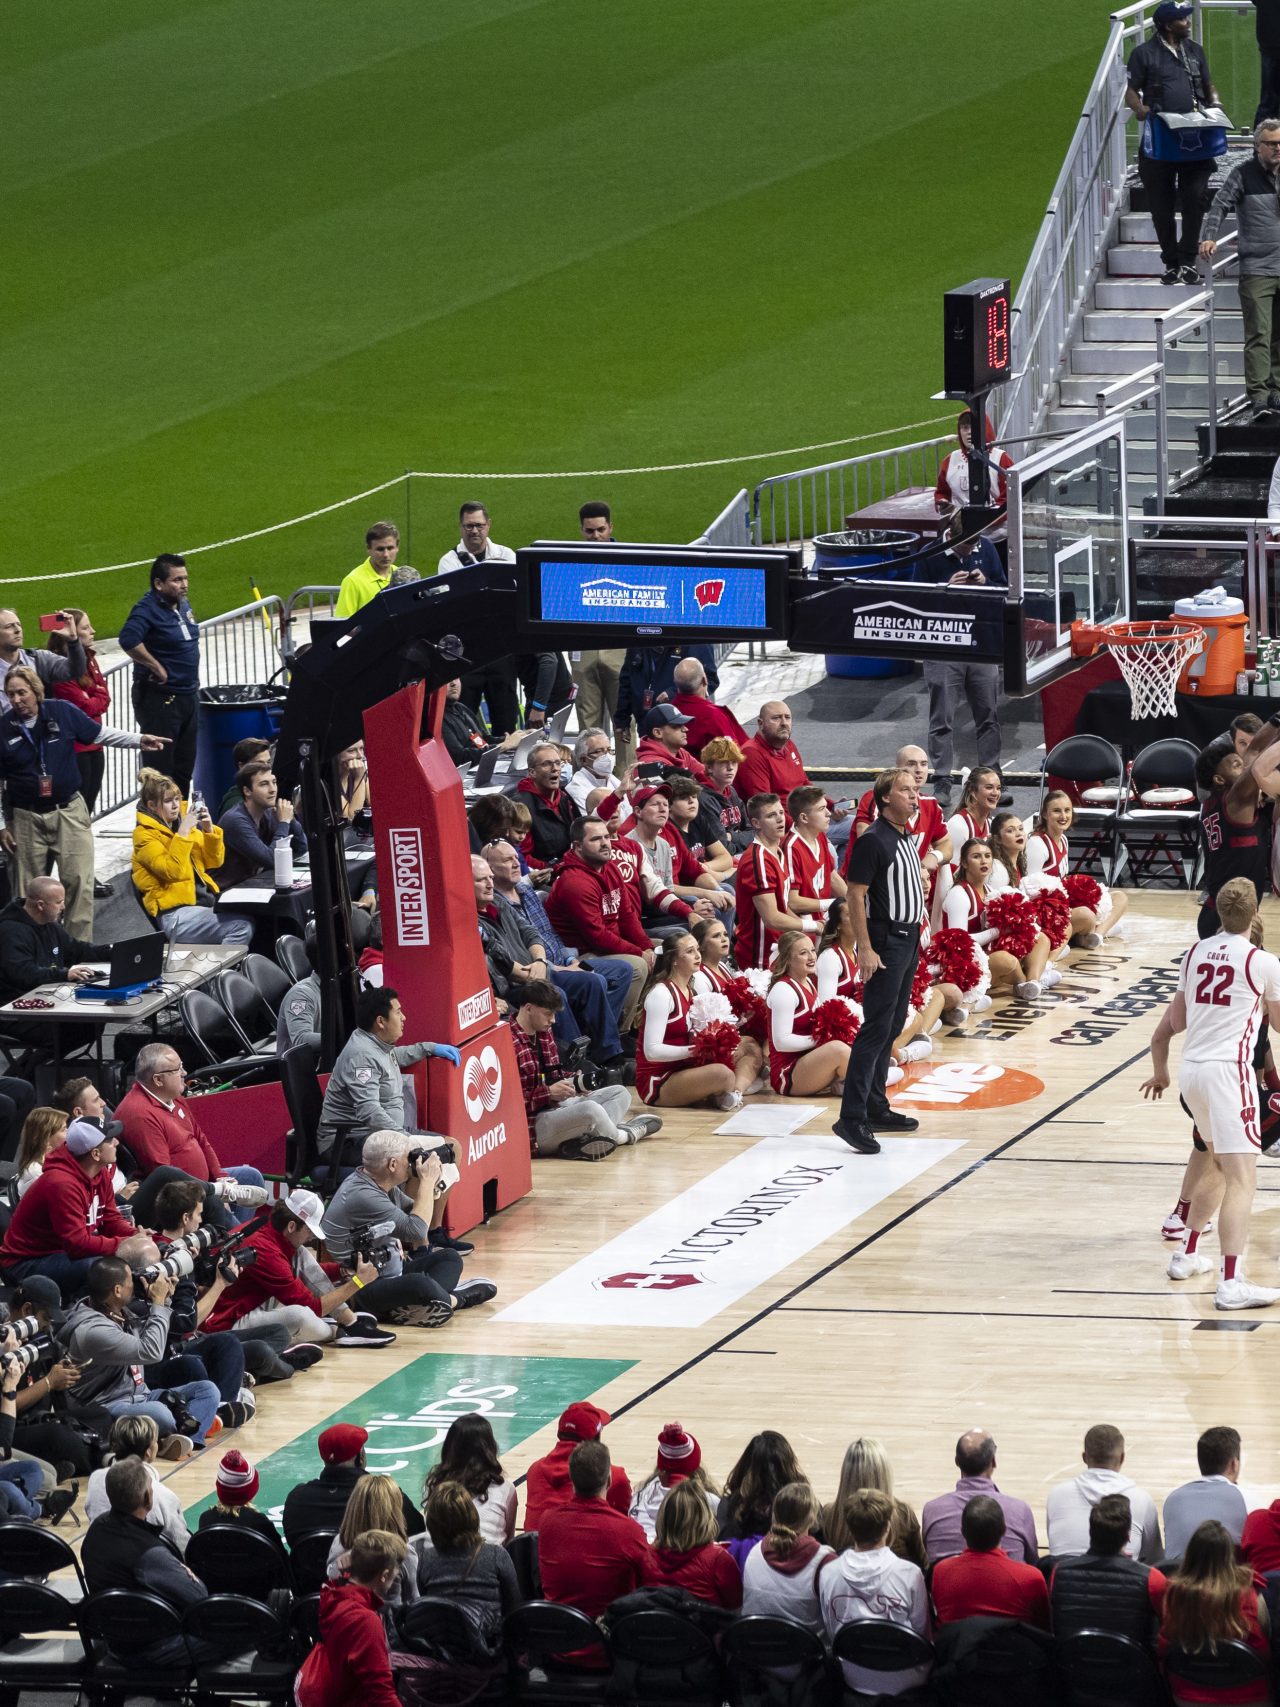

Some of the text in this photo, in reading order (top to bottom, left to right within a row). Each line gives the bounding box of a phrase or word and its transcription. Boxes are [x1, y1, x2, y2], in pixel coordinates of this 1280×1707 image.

[582, 588, 666, 600] AMERICAN FAMILY
[588, 597, 659, 607] INSURANCE
[854, 614, 974, 633] AMERICAN FAMILY
[862, 628, 963, 643] INSURANCE
[394, 832, 425, 942] INTERSPORT
[1062, 953, 1133, 982] you
[1207, 951, 1231, 962] CROWL
[1195, 962, 1235, 1007] 22
[459, 991, 491, 1027] INTERSPORT
[1049, 1020, 1130, 1046] can
[468, 1121, 507, 1166] Aurora
[649, 1164, 845, 1266] VICTORINOX
